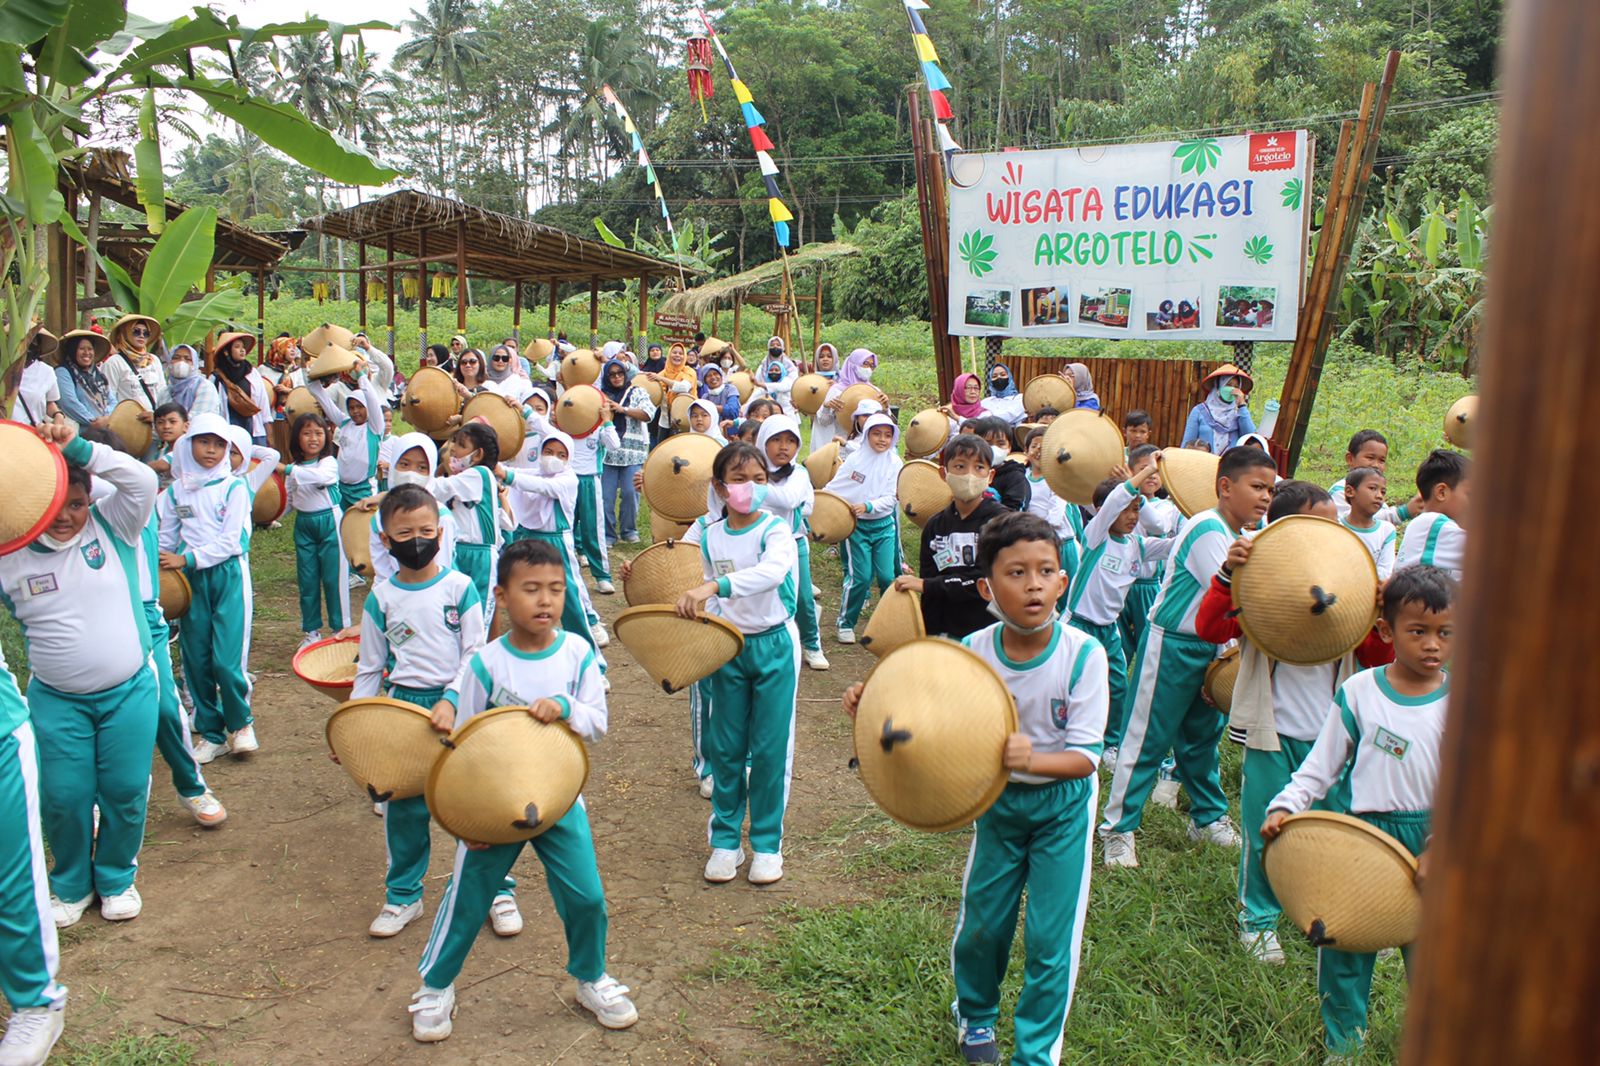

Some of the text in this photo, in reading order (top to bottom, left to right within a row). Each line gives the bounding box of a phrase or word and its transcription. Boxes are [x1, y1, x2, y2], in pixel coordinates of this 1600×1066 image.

[1253, 151, 1292, 165] Argotelo
[986, 179, 1254, 225] WISATA EDUKASI
[1034, 230, 1183, 266] ARGOTELO
